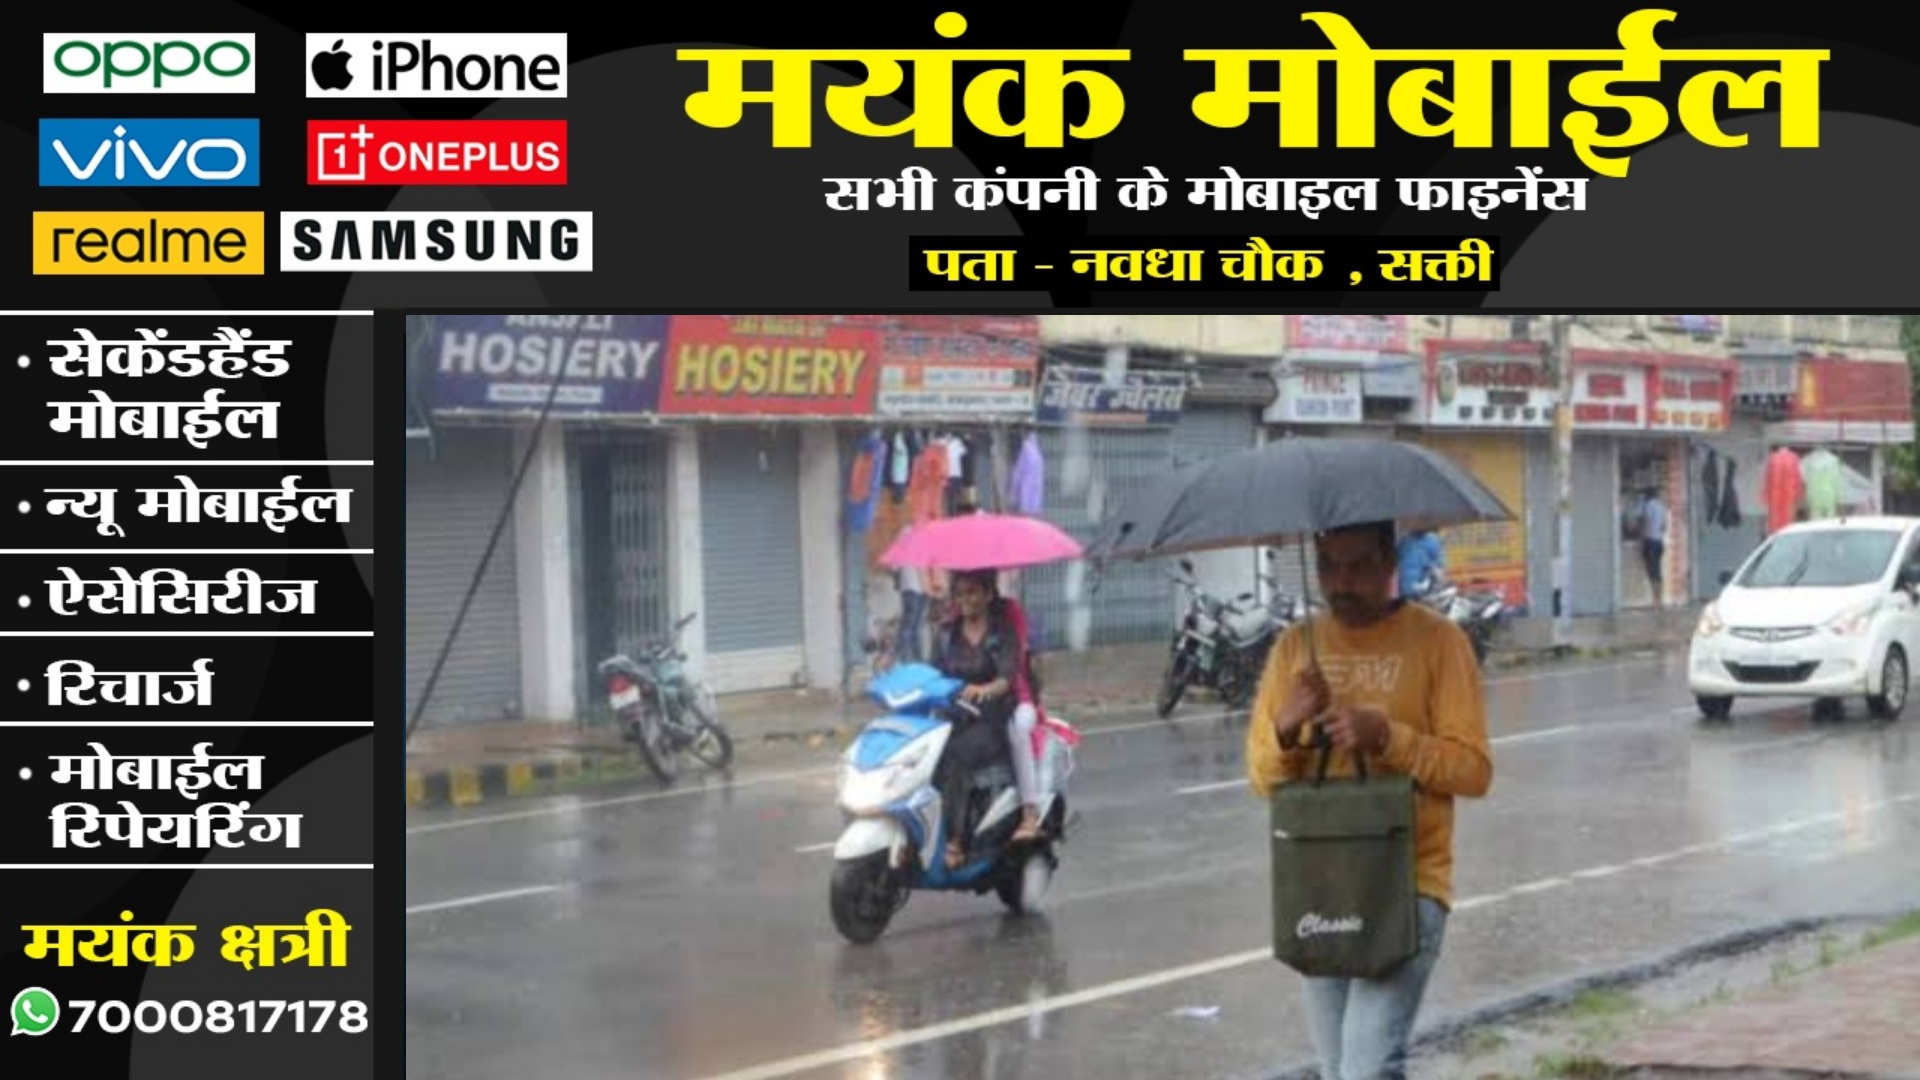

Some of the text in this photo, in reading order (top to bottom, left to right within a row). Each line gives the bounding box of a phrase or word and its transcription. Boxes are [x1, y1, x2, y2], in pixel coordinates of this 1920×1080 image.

[439, 331, 660, 380] HOSIERY
[674, 343, 866, 397] HOSIERY
[1296, 912, 1364, 938] Classic
